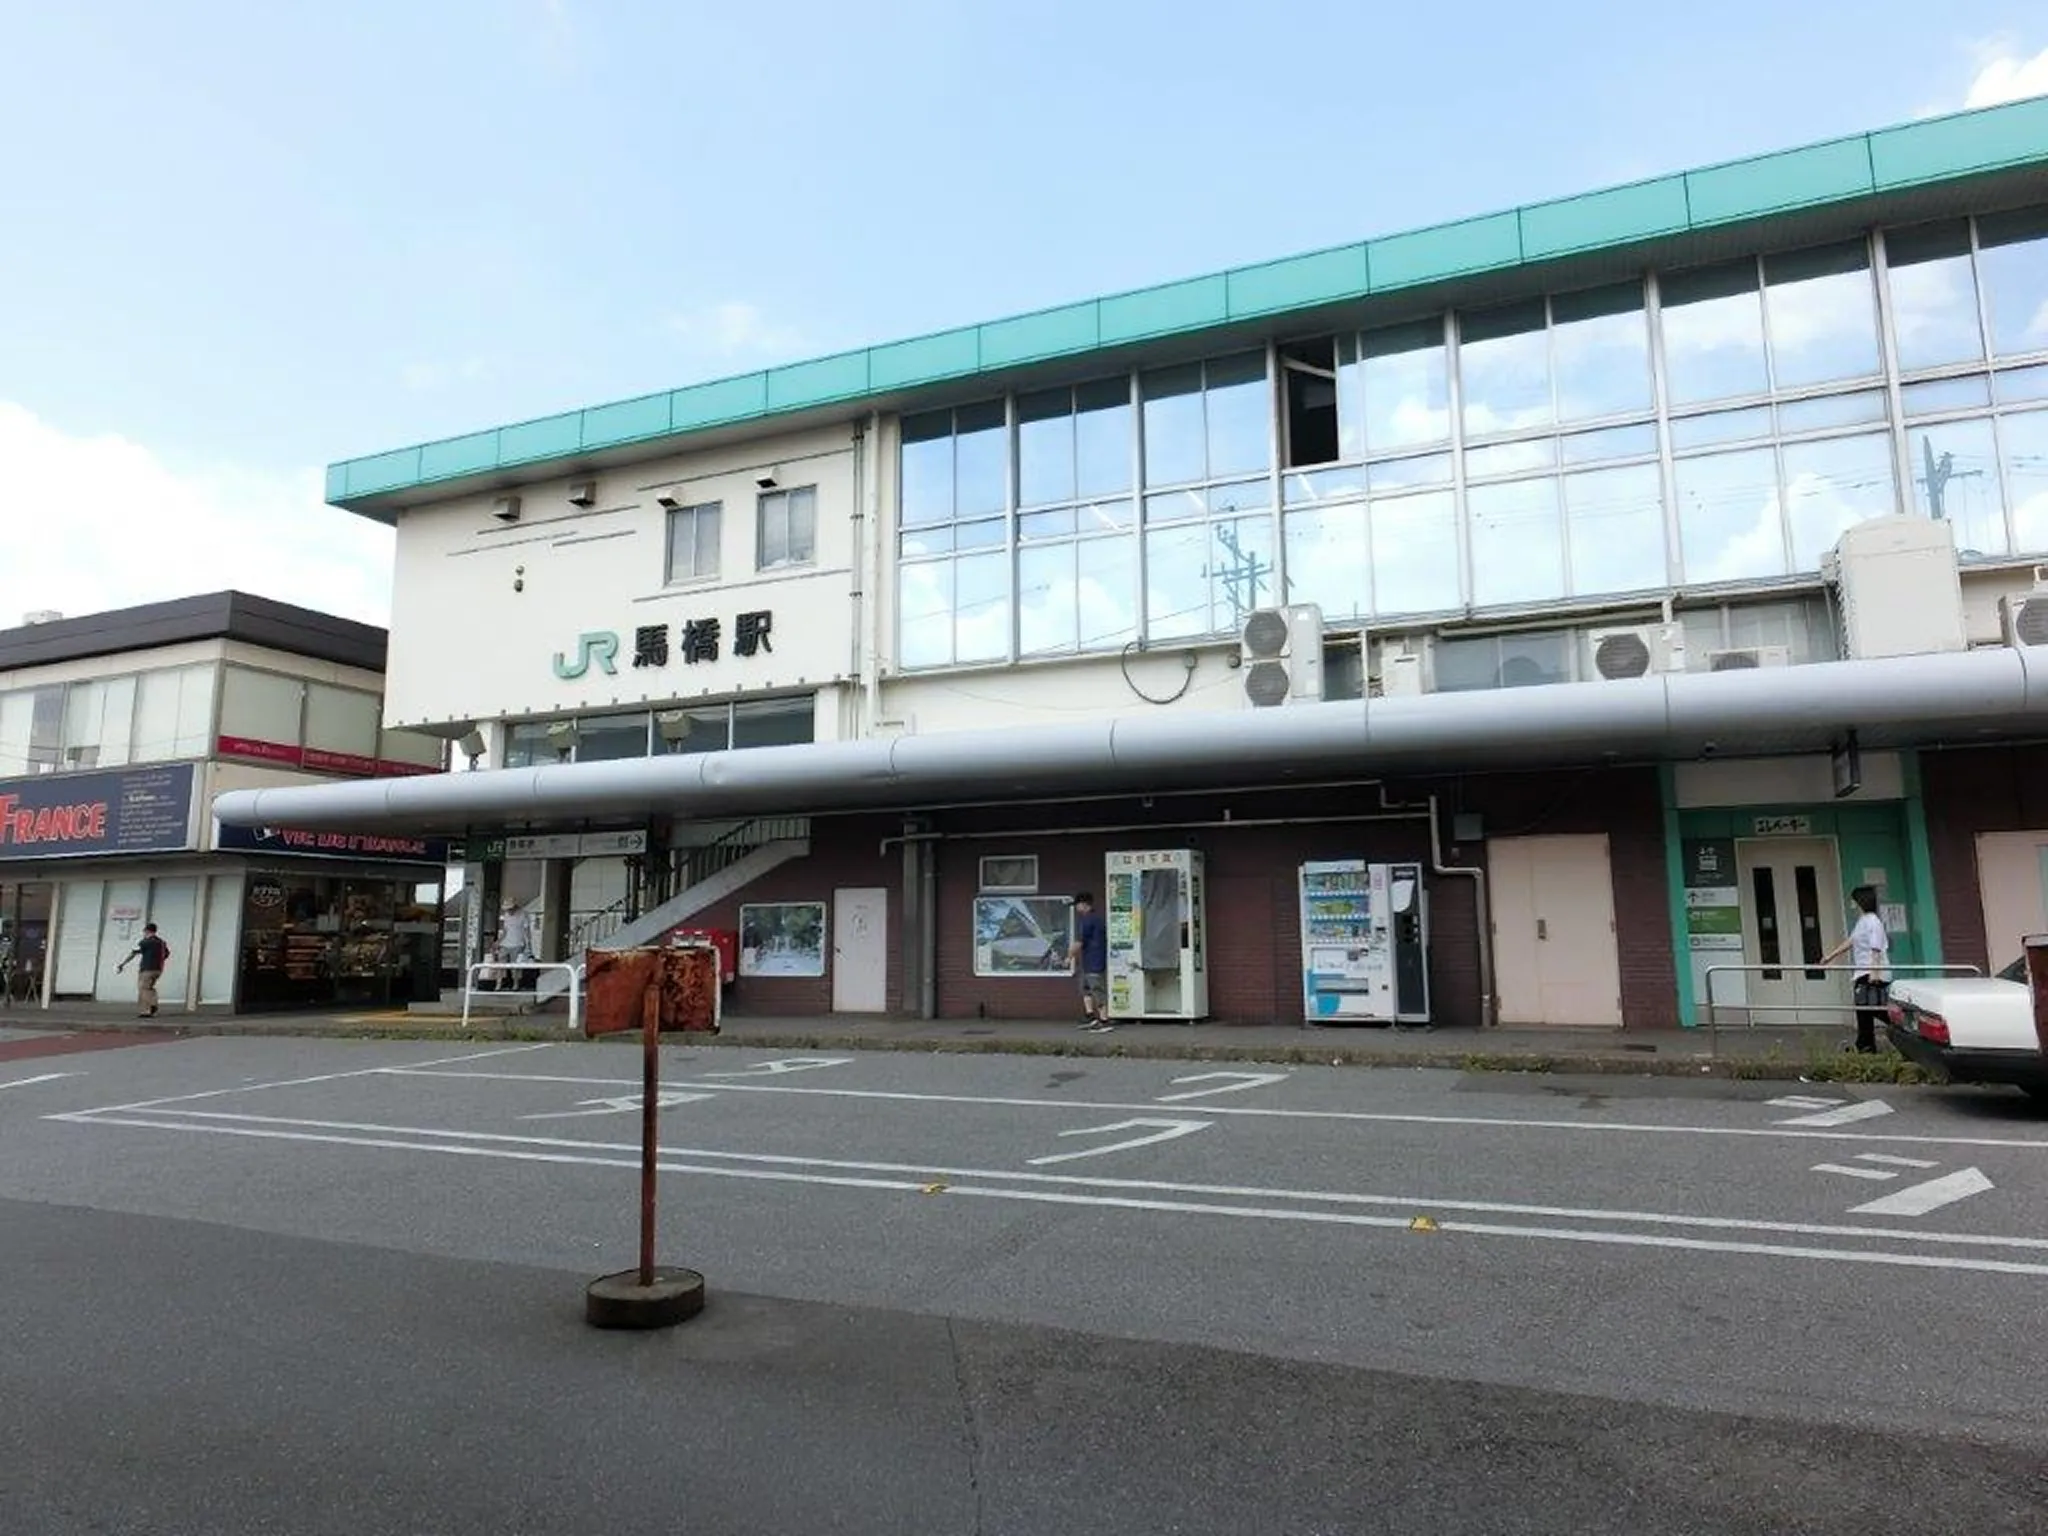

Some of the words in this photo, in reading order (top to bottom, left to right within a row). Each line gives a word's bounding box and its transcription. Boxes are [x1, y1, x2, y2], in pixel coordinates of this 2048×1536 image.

[554, 630, 619, 679] JR
[632, 609, 775, 669] 馬橋駅
[0, 793, 108, 845] FRANCE
